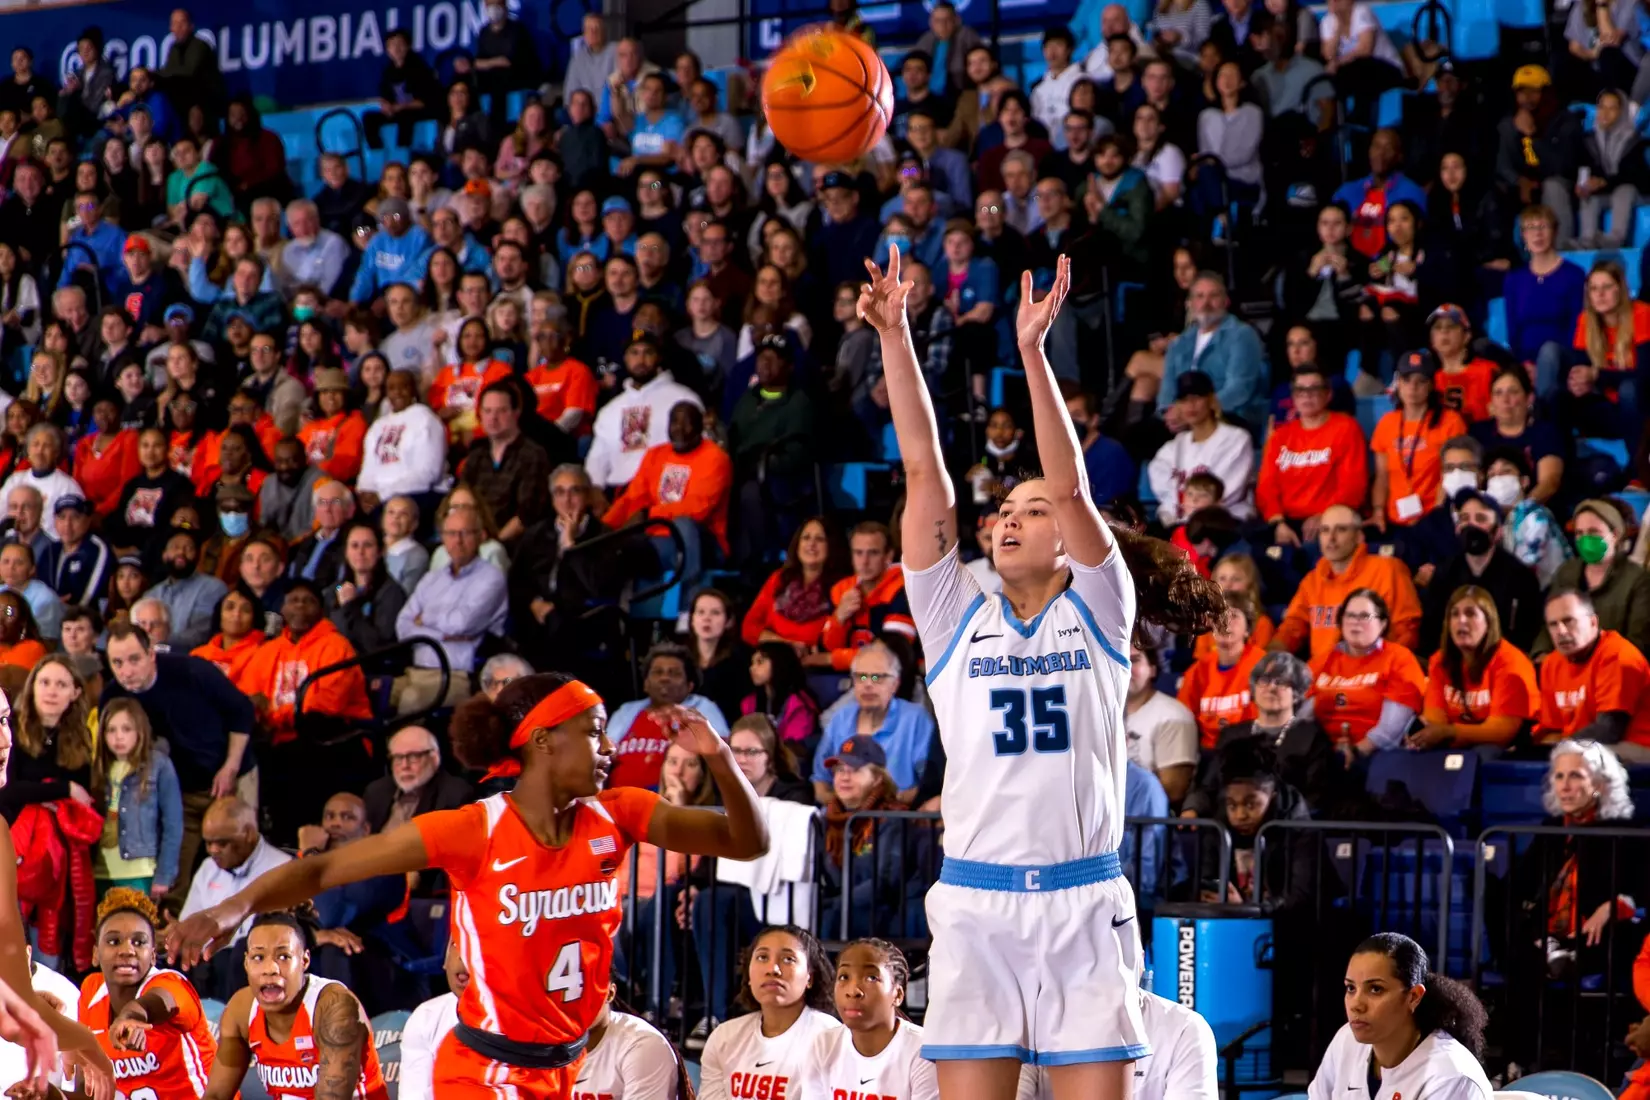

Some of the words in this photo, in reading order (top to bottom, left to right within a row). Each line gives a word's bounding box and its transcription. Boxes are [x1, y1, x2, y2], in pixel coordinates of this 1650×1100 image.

[1057, 628, 1072, 638] Ivy
[969, 649, 1091, 678] COLUMBIA
[989, 685, 1071, 757] 35
[1025, 869, 1040, 890] C
[498, 877, 618, 937] Syracuse
[546, 940, 584, 1003] 4
[114, 1052, 160, 1078] cuse
[731, 1072, 788, 1100] CUSE
